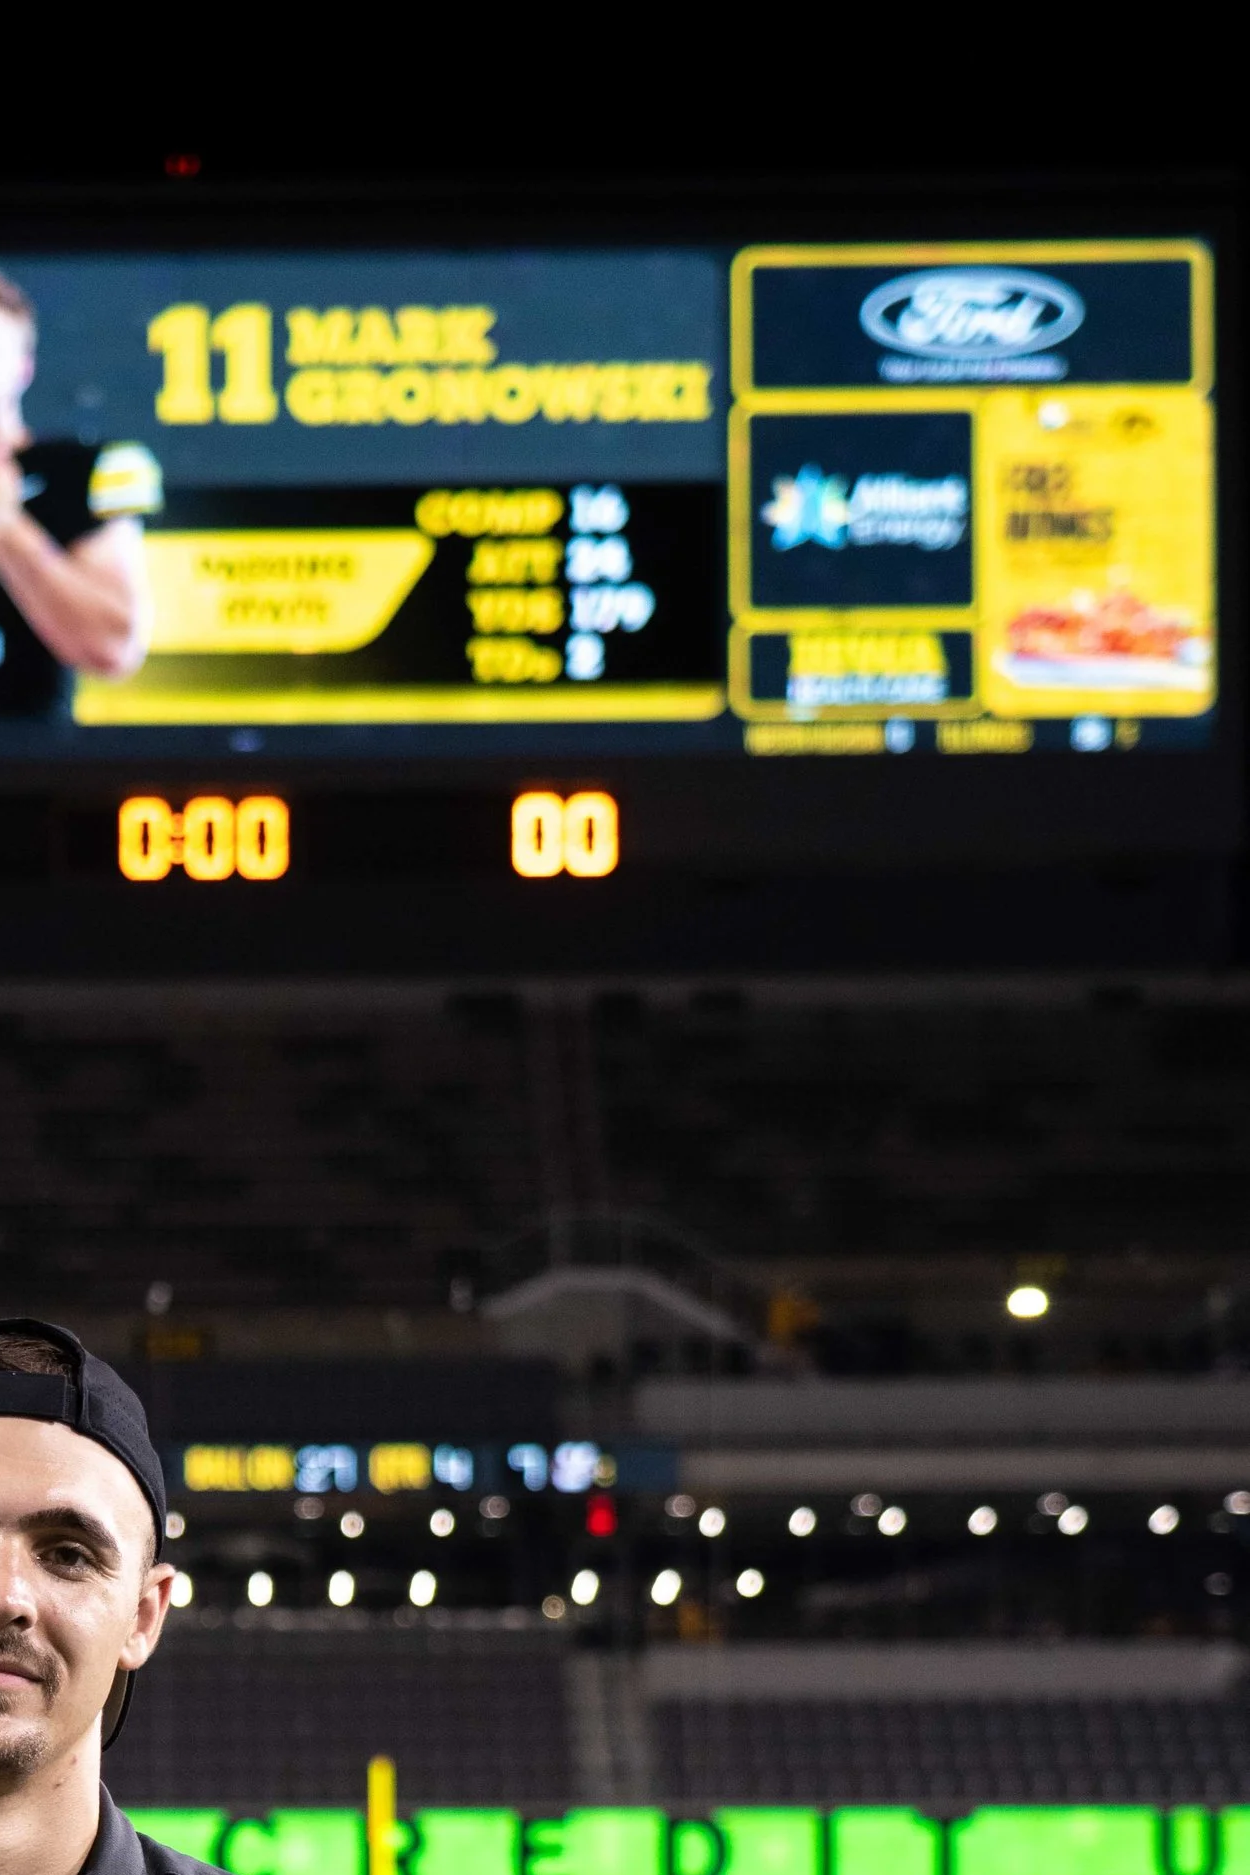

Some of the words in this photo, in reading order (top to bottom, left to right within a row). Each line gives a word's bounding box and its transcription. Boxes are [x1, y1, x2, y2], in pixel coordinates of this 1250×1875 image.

[285, 307, 498, 366] MARK
[898, 277, 1043, 348] Ford
[149, 303, 278, 425] 11
[286, 363, 713, 425] GRONOWSKI
[414, 489, 563, 537] COMP
[118, 797, 290, 881] 0:00
[511, 792, 619, 877] 00
[295, 1444, 357, 1493] 27
[434, 1444, 473, 1491] 4
[507, 1444, 547, 1491] 7
